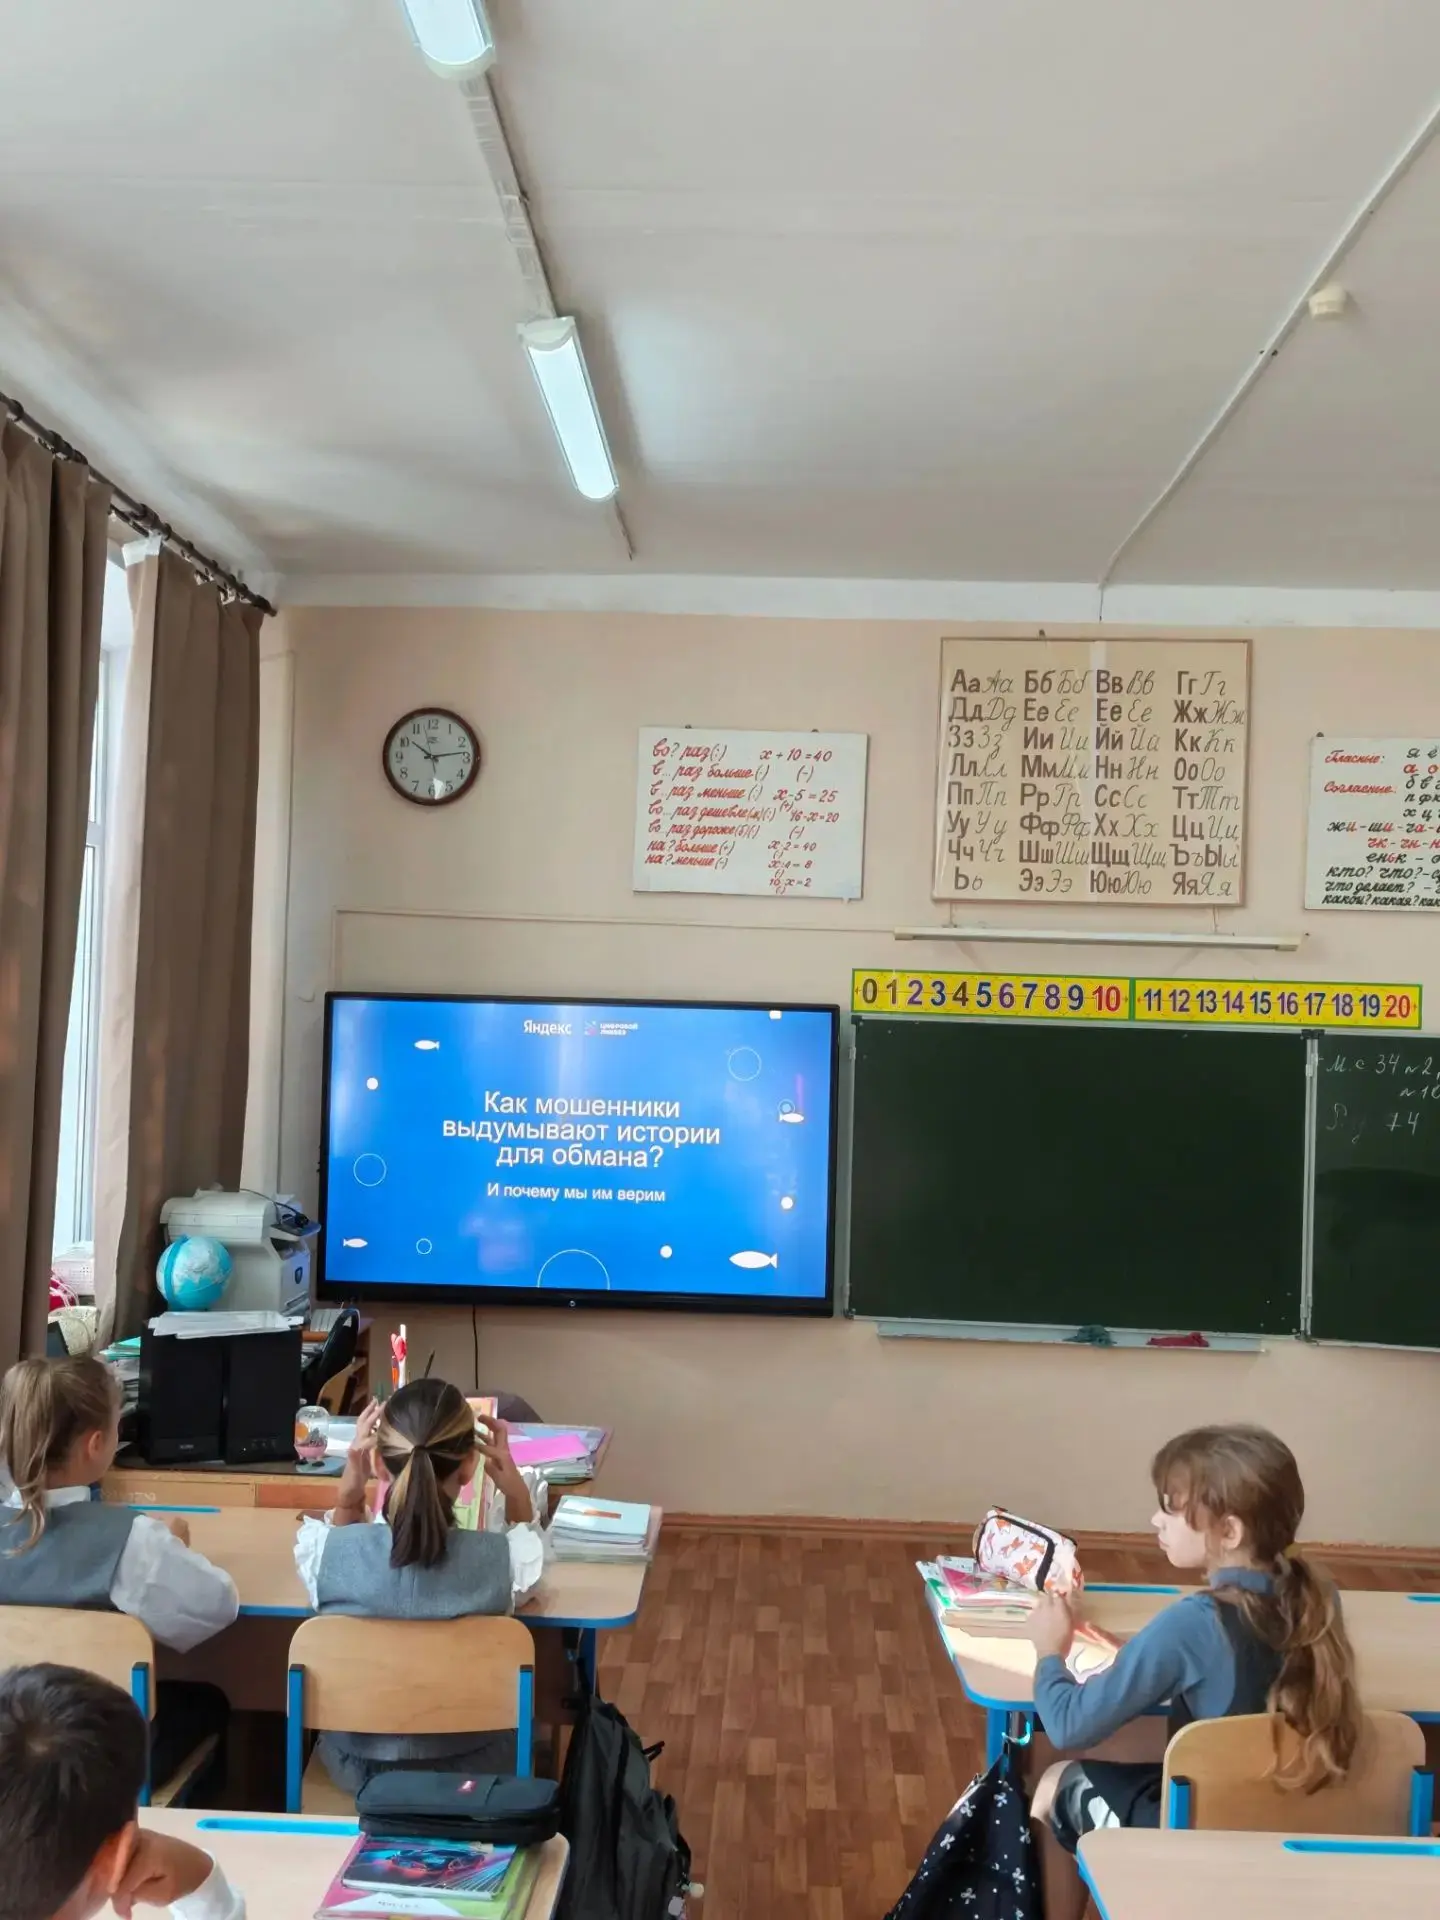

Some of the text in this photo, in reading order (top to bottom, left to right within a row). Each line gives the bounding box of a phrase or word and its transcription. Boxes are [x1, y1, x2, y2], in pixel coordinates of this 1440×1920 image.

[412, 724, 420, 734] 11
[427, 719, 439, 730] 12
[400, 737, 409, 747] 10
[458, 736, 466, 748] 2
[395, 751, 403, 763] 9
[462, 751, 471, 763] 3
[787, 748, 802, 761] 10
[400, 767, 408, 779] 8
[457, 768, 465, 780] 4
[412, 781, 419, 792] 7
[445, 781, 453, 792] 5
[819, 789, 838, 803] 25
[862, 978, 1121, 1012] 0 1 2 3 4 5 6 7 8 9 10
[1144, 988, 1411, 1019] 11 12 13 14 15 16 17 18 19 20
[524, 1020, 572, 1035] Яндекс
[1375, 1054, 1400, 1075] 34
[484, 1091, 680, 1118] Как мошенники
[443, 1119, 720, 1148] выдумывают истории
[496, 1144, 664, 1168] для обмана?
[487, 1183, 665, 1203] И почему мы им верим
